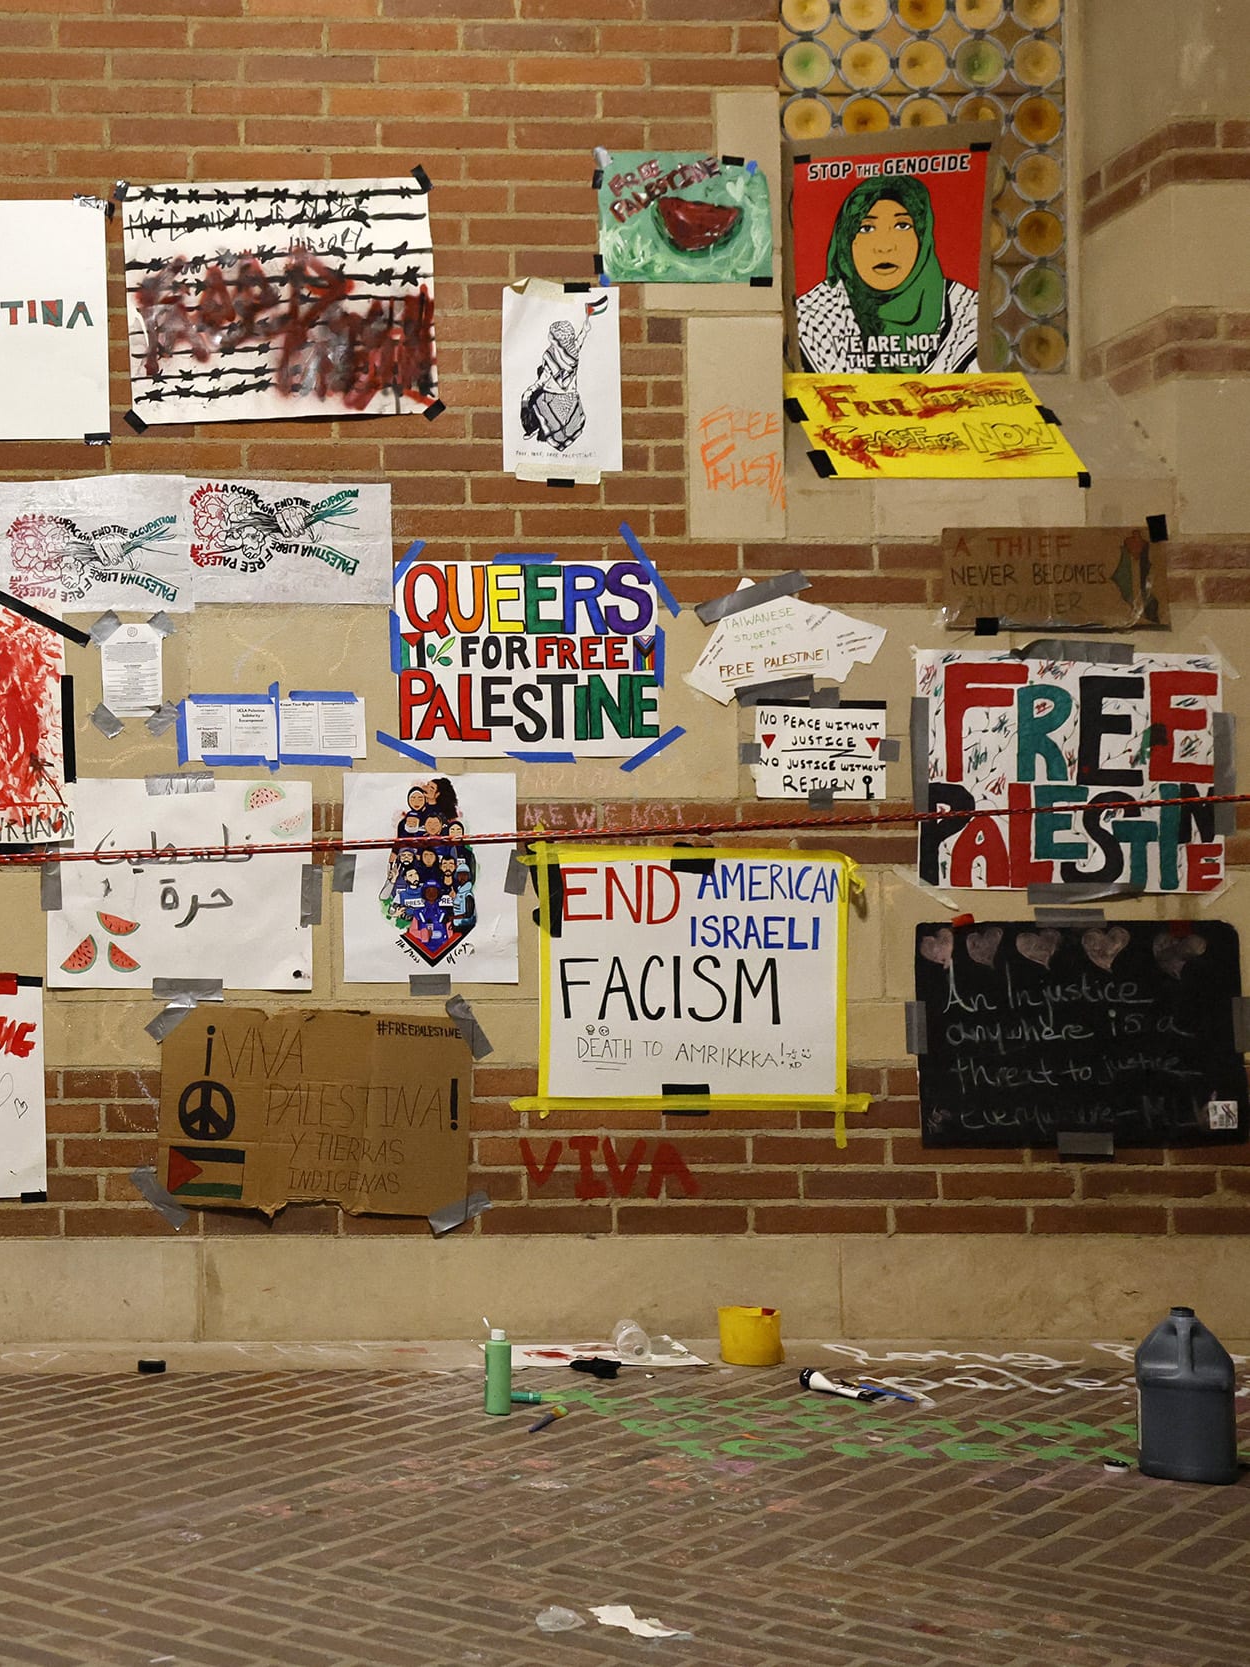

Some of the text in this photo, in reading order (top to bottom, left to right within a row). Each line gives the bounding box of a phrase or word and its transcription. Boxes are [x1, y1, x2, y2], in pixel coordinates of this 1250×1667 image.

[808, 154, 971, 181] STOP THE GENOCIDE
[832, 332, 941, 352] WE ARE NOT
[846, 352, 932, 369] THE ENEMY
[813, 383, 913, 420] FREE
[963, 421, 1058, 453] NOW
[952, 534, 1073, 559] A THIEF
[950, 563, 1108, 585] NEVER BECOMES
[404, 562, 652, 638] QUEERS
[722, 607, 796, 630] TAIWANESE
[461, 635, 630, 670] FOR FREE
[719, 649, 830, 677] FREE PALESTINE!
[400, 668, 660, 742] PALESTINE
[760, 711, 880, 731] NO PEACE WITHOUT
[944, 662, 1218, 786] FREE
[791, 736, 857, 748] JUSTICE
[759, 756, 887, 772] NO JUSTICE WITHOUT
[783, 774, 855, 793] RETURN
[918, 782, 1225, 893] PALESTINE
[561, 862, 848, 925] END AMERICAN
[690, 915, 820, 950] ISRAELI
[560, 955, 781, 1025] FACISM
[943, 957, 997, 1014] An
[377, 1020, 462, 1039] #FREEPALESTINE
[946, 1009, 1194, 1054] anywhere is a
[577, 1036, 632, 1059] DEATH
[641, 1040, 663, 1057] TO
[1065, 1057, 1092, 1081] to
[265, 1078, 459, 1131] PALESTINA!
[289, 1132, 406, 1164] Y TIERRAS
[288, 1167, 400, 1194] INDIGENAS
[519, 1135, 701, 1200] VIVA
